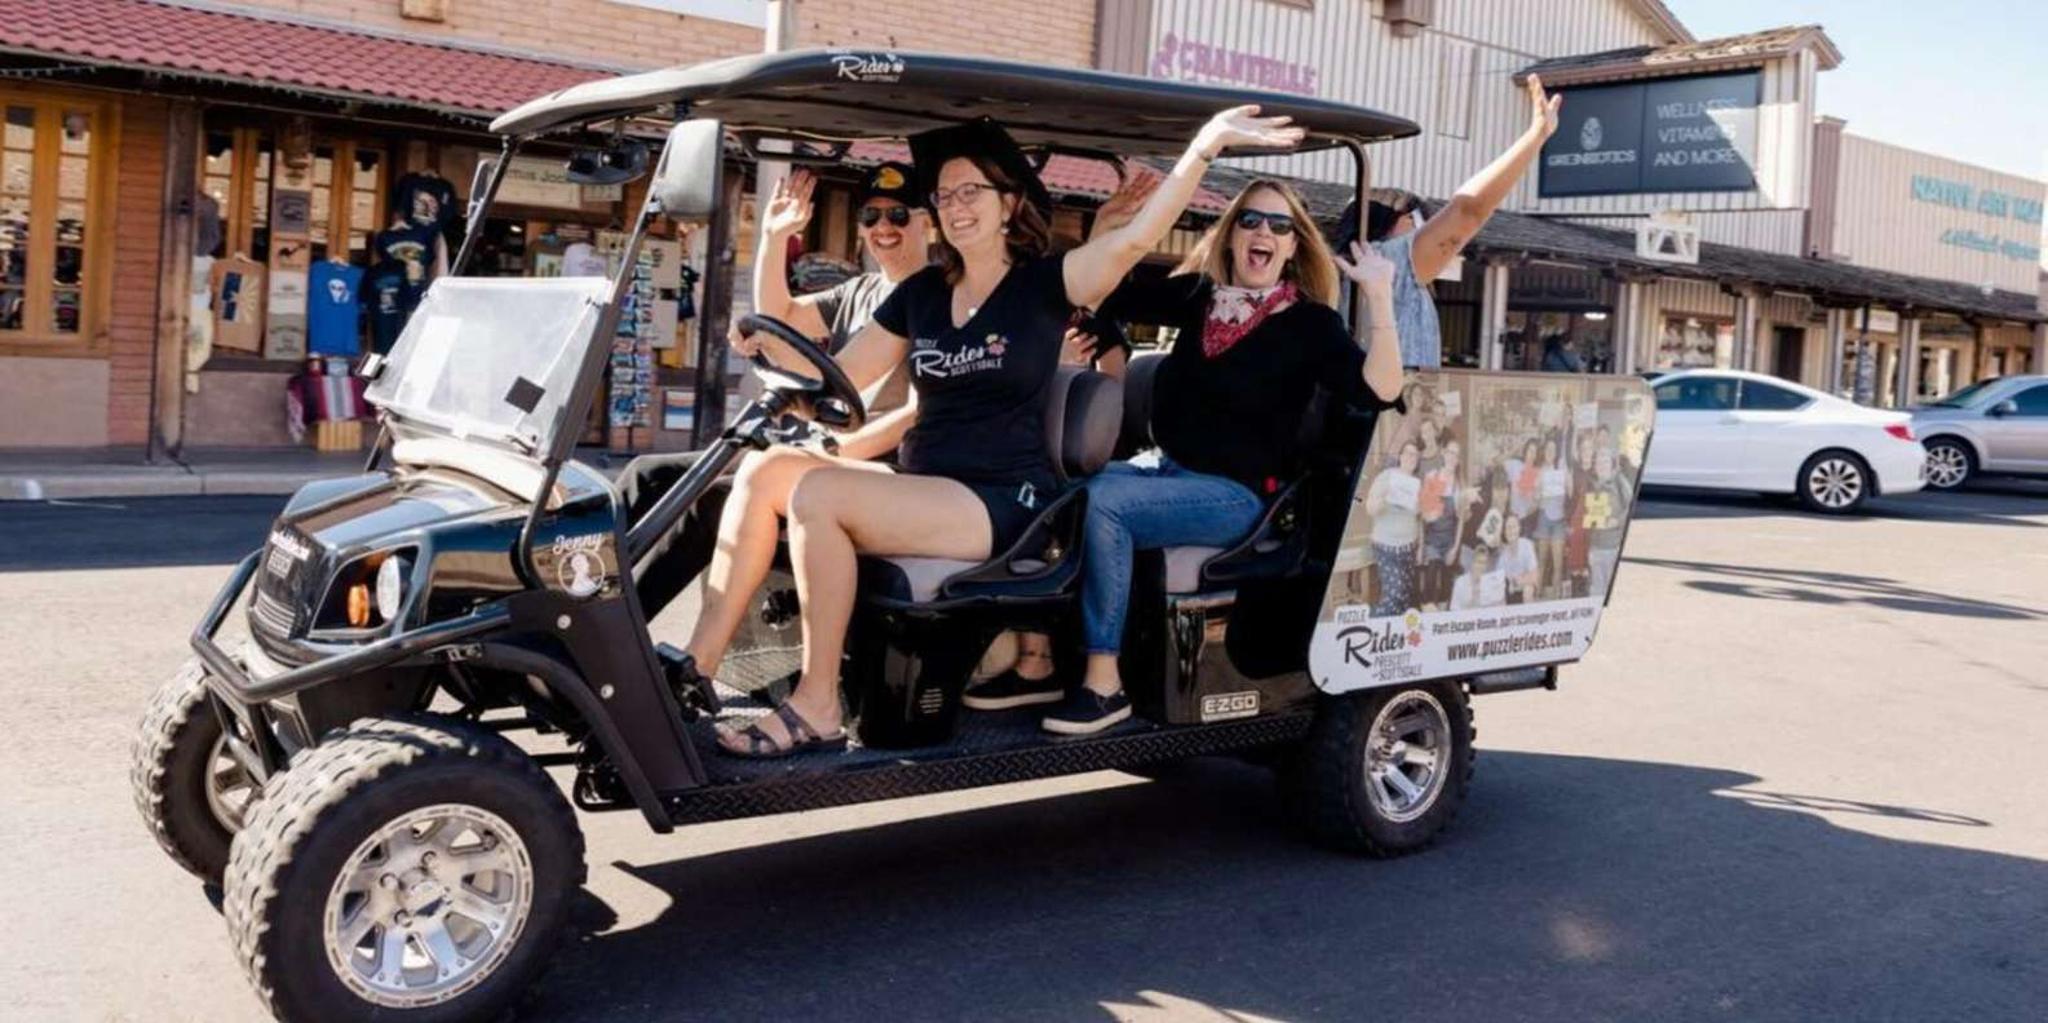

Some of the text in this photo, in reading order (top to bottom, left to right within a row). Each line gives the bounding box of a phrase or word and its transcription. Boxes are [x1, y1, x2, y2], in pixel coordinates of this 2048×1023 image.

[831, 55, 891, 81] Rides
[1654, 148, 1737, 167] AND MORE
[1910, 174, 1974, 211] NATIVE
[1976, 188, 2007, 218] ART
[910, 344, 985, 378] Rides
[950, 358, 1002, 377] SCOTTSDALE
[552, 533, 603, 556] Jenny
[1337, 608, 1368, 624] PUZZLE
[1336, 621, 1405, 669] Rides
[1446, 630, 1573, 661] www.puzzlerides.com
[1203, 693, 1257, 715] EZGO
